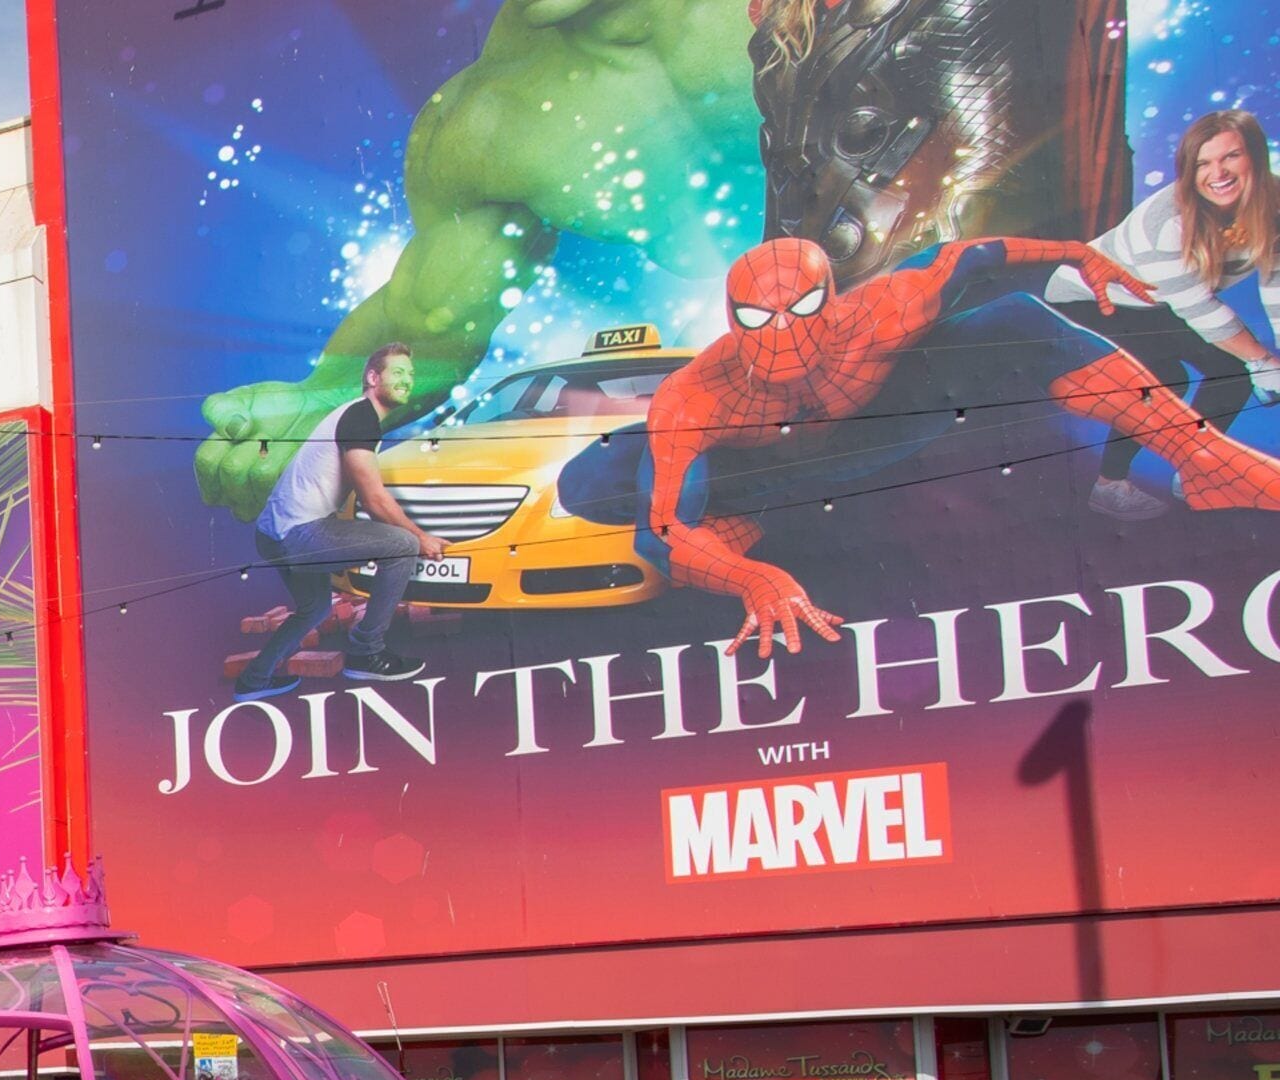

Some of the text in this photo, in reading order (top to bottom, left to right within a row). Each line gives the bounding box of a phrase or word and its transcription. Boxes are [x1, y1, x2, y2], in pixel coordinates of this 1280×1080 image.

[600, 329, 641, 346] TAXI
[410, 562, 460, 577] POOL
[158, 676, 446, 795] JOIN
[474, 632, 806, 756] THE
[758, 741, 830, 766] WITH
[668, 772, 944, 878] MARVEL
[1205, 1015, 1280, 1047] Mada
